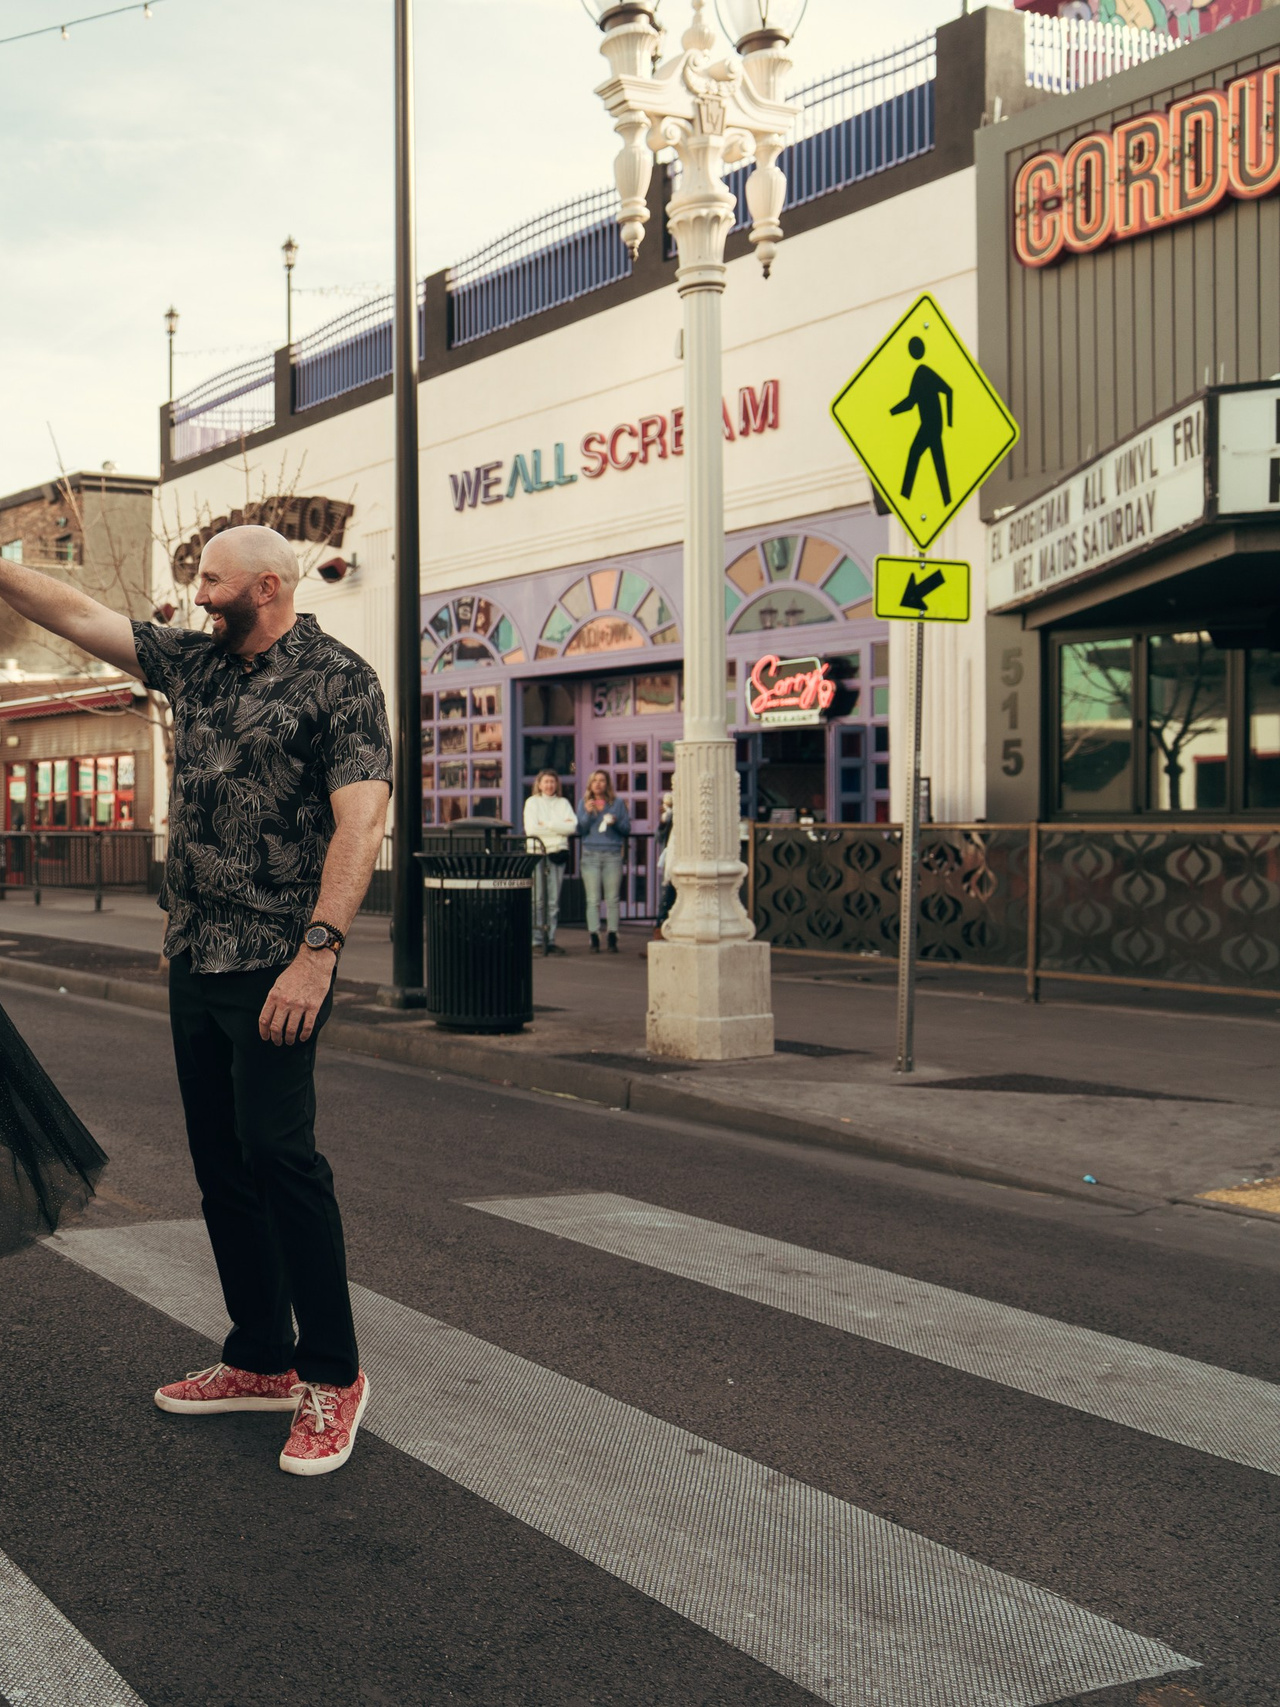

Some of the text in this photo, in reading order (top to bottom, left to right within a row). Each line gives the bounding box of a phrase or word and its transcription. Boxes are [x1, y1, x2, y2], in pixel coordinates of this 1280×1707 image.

[1014, 62, 1280, 268] CORDU
[449, 378, 780, 513] WE ALL SCREM
[1083, 466, 1106, 515] ALL
[1114, 436, 1158, 497] VINYL
[1173, 410, 1202, 466] FRI
[1082, 489, 1157, 562] SATURDAY
[1001, 648, 1024, 777] 515
[492, 879, 506, 887] CITY
